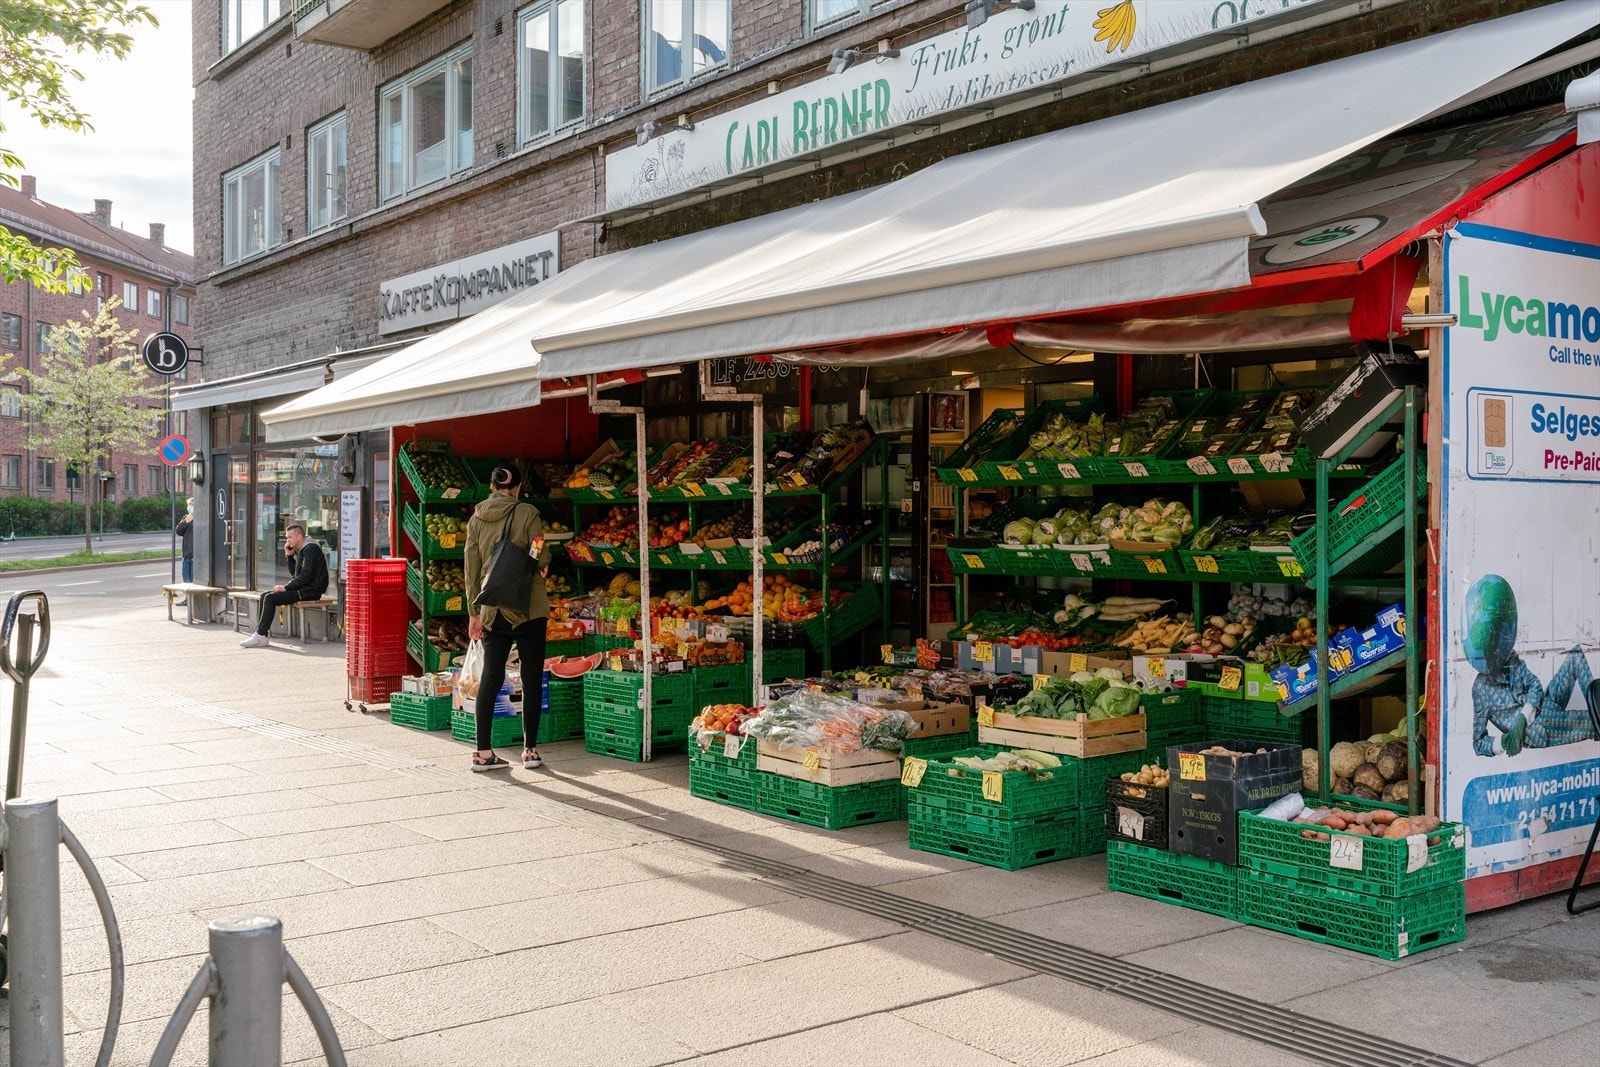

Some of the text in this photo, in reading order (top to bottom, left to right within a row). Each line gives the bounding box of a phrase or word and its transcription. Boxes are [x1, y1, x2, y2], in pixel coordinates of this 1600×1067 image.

[905, 3, 1070, 94] Frukt, grønt
[793, 78, 891, 154] BERNER
[379, 249, 553, 320] KAFFEKOMPANIET
[1549, 345, 1571, 363] Call
[1572, 347, 1592, 366] the
[1531, 403, 1600, 441] Selges
[1247, 788, 1260, 801] AIR
[1261, 785, 1280, 799] DRIED
[1560, 801, 1575, 821] 71
[1579, 796, 1595, 817] 71
